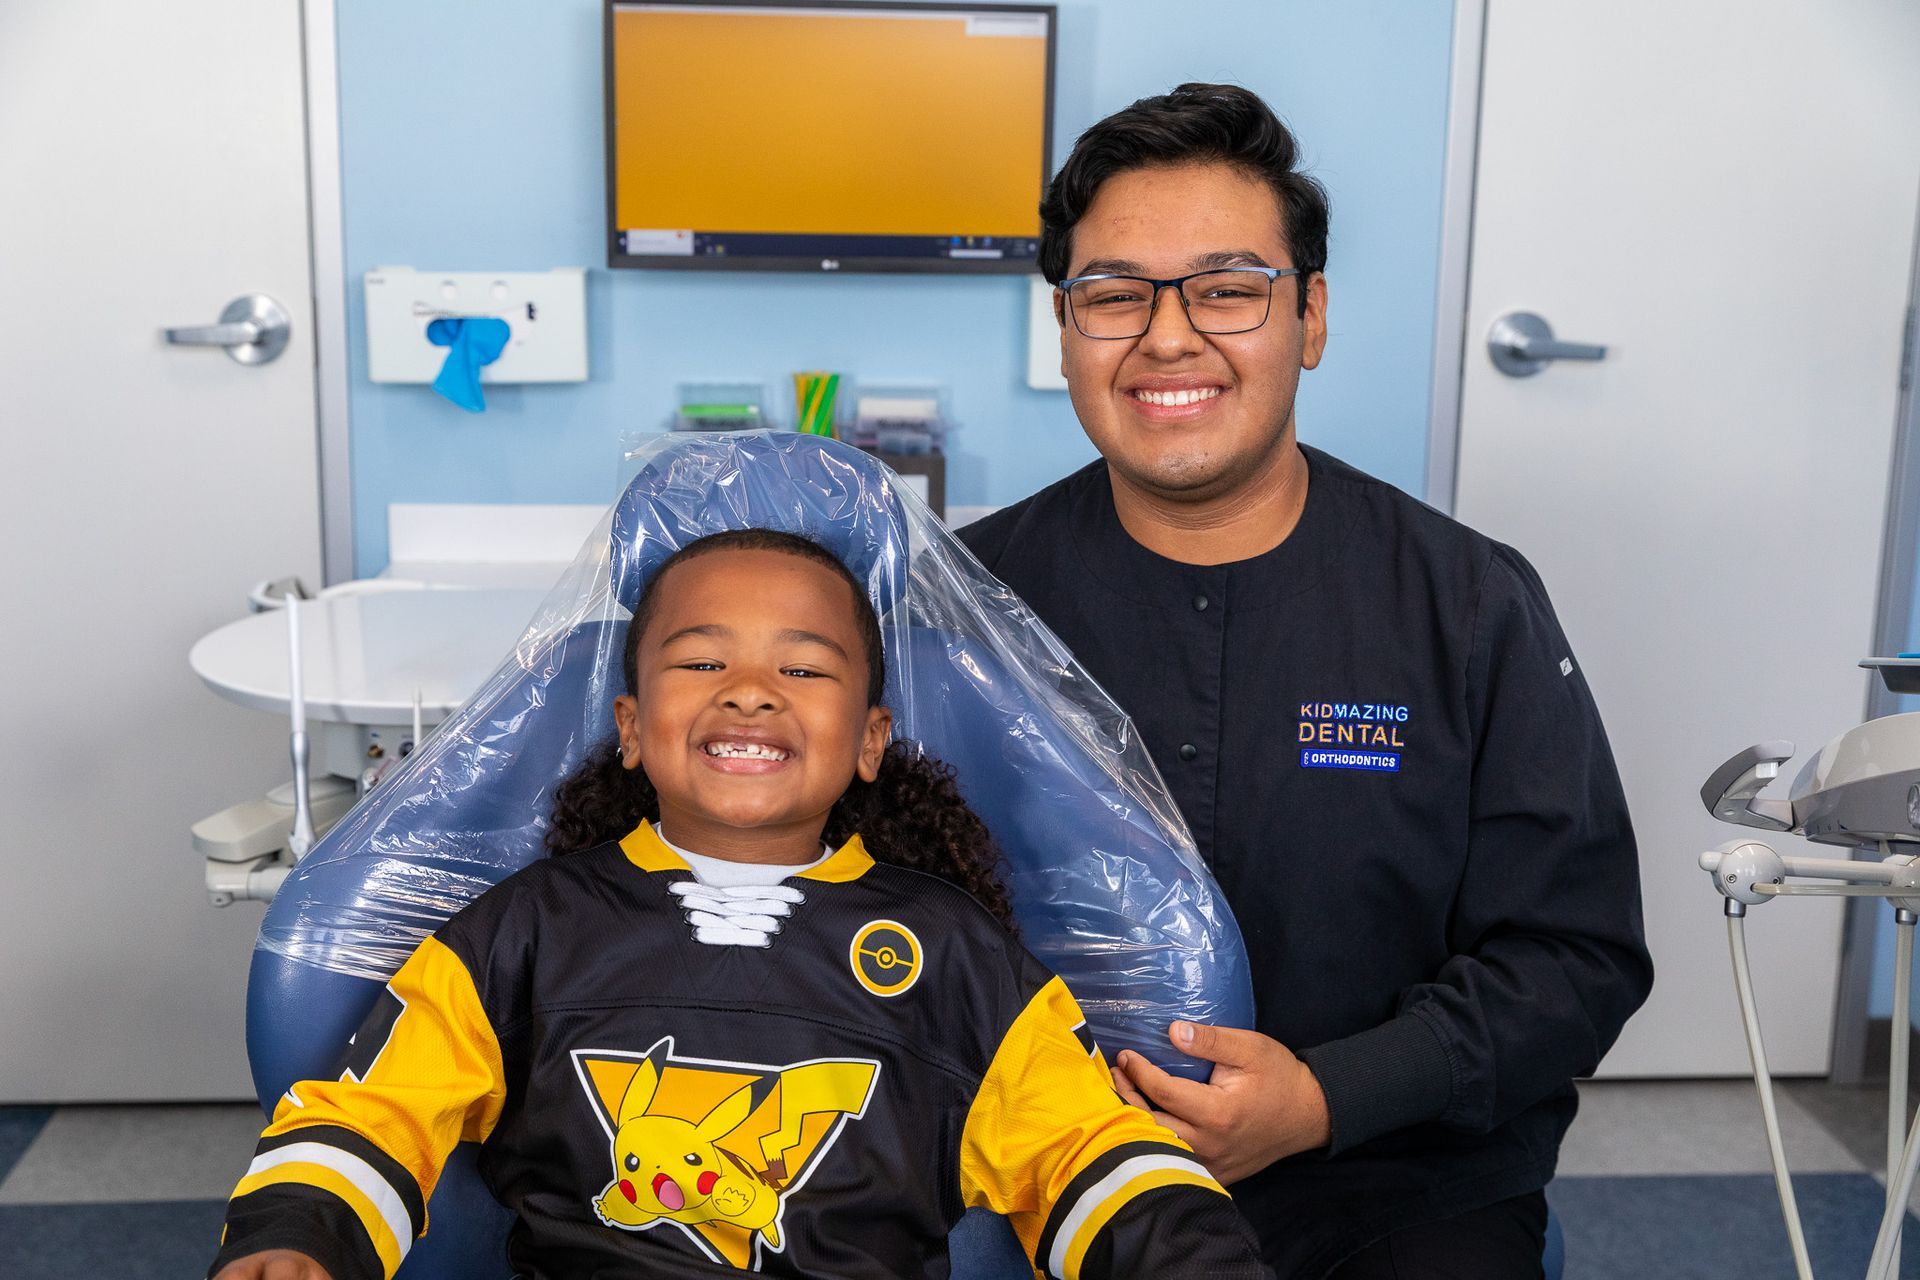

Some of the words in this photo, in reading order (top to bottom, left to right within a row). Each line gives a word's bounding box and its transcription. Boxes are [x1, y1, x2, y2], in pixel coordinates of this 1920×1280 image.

[1301, 703, 1408, 722] KIDMAZING
[1299, 722, 1404, 747] DENTAL
[1311, 753, 1396, 768] ORTHODONTICS
